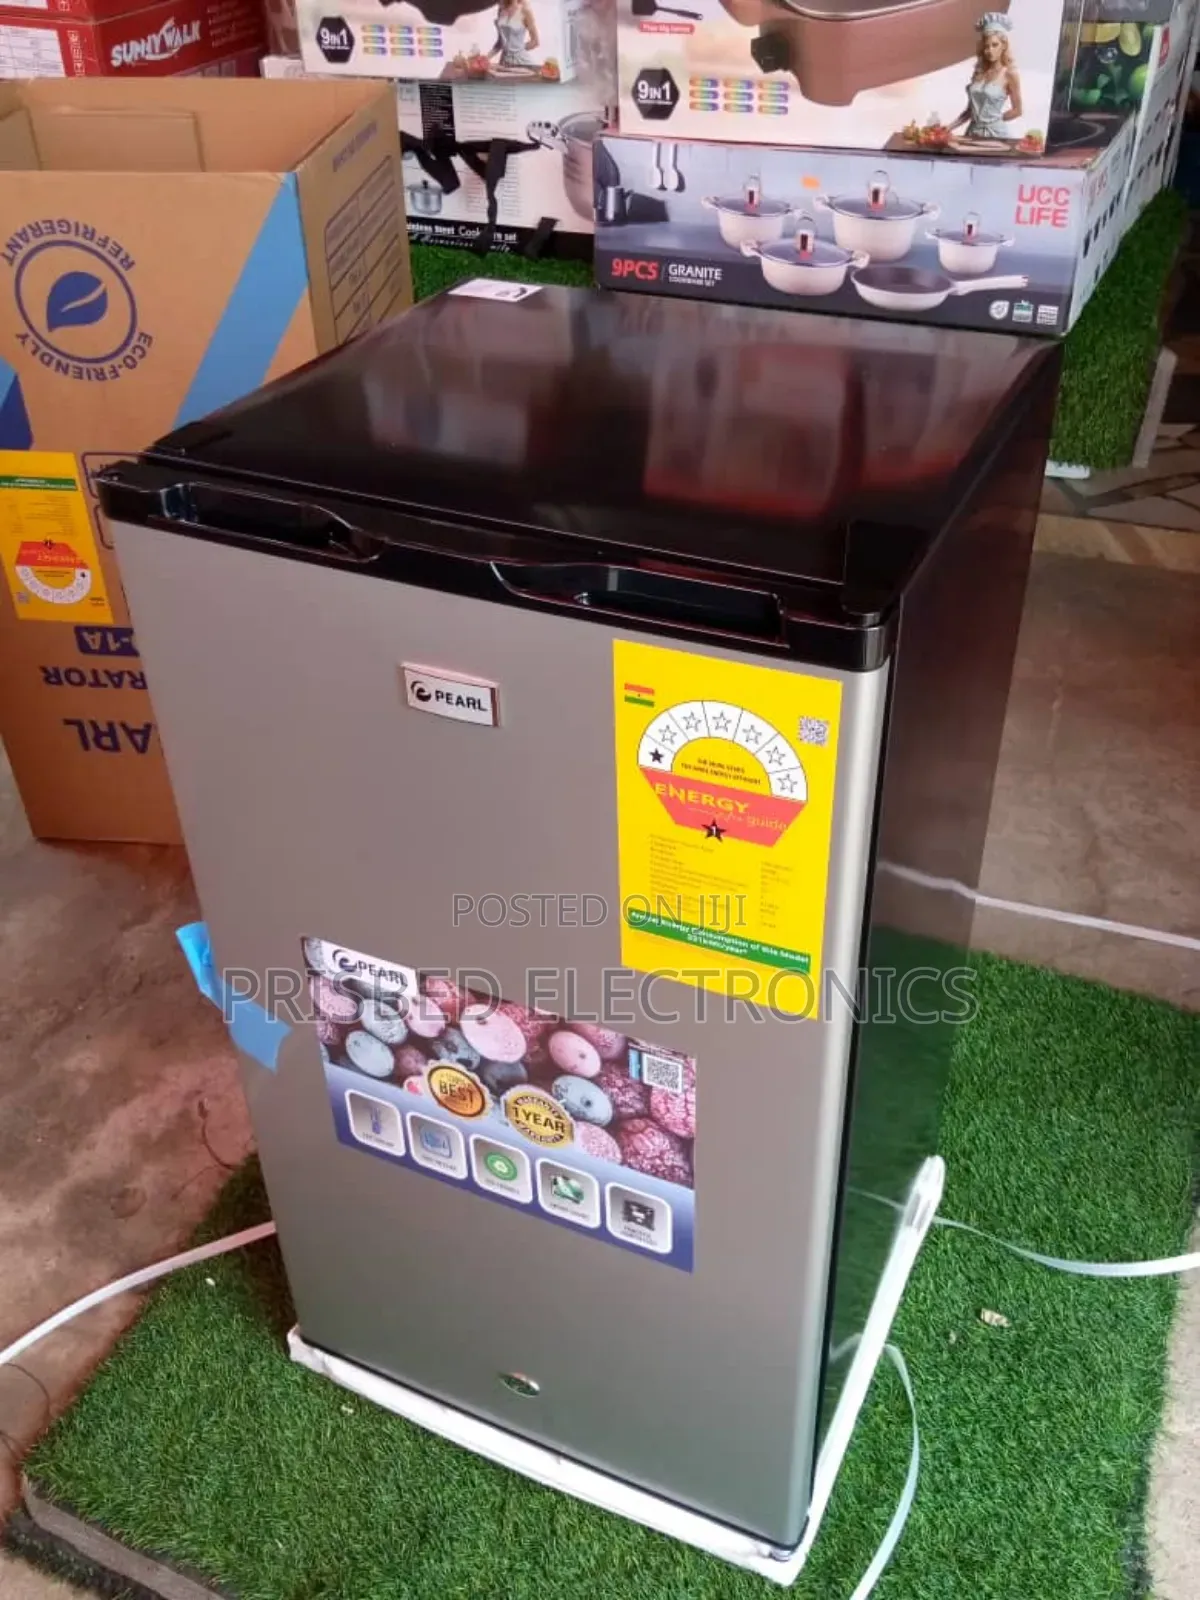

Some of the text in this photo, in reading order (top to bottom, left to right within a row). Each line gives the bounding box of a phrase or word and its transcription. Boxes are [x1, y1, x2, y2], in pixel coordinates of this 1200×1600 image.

[110, 17, 201, 68] SUNNYWALK
[637, 79, 671, 101] 9IN1
[1017, 183, 1071, 205] UCC
[1014, 206, 1069, 227] LIFE
[0, 218, 136, 271] REFRIGERANT
[611, 257, 723, 281] 9PCS GRANITE
[14, 331, 154, 381] ECO-FRIENDLY
[80, 629, 130, 653] -1A
[39, 665, 148, 690] RATOR
[435, 689, 488, 712] PEARL
[62, 717, 154, 755] ARL
[654, 782, 750, 813] ENERGY
[747, 812, 787, 832] guide
[358, 959, 408, 988] PEARL
[439, 1079, 474, 1104] BEST
[512, 1106, 521, 1118] 1
[522, 1108, 566, 1133] YEAR
